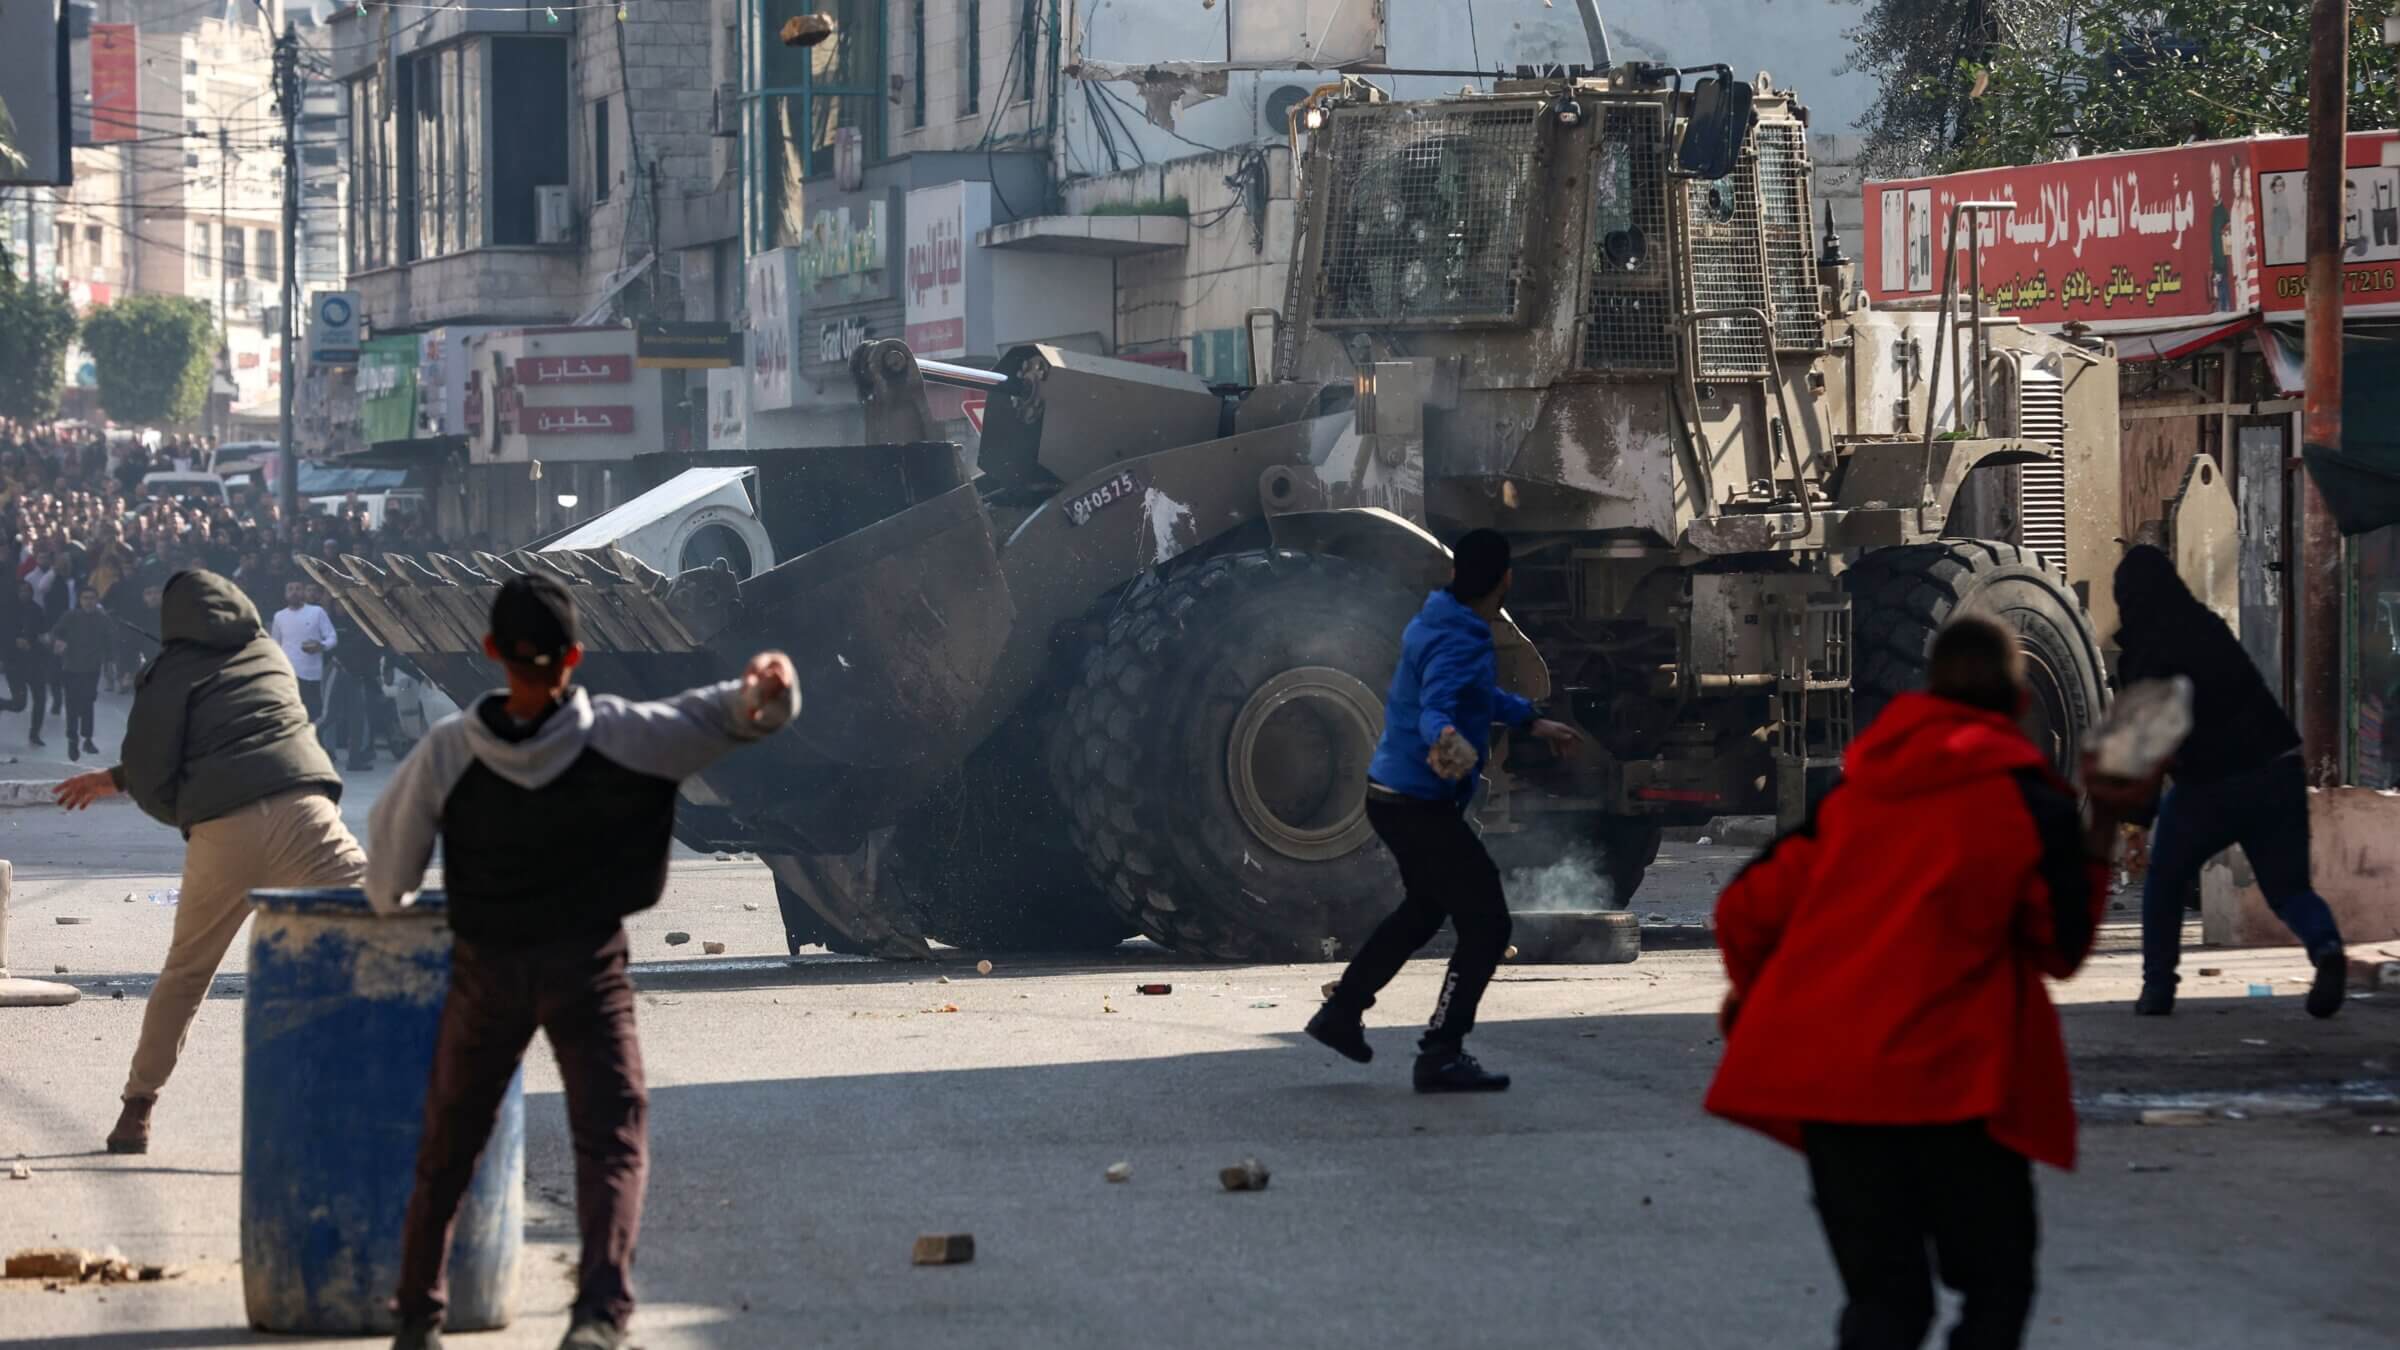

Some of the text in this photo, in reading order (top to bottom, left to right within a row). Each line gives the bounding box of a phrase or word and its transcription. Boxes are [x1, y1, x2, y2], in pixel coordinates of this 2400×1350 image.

[1940, 186, 2001, 268] الجهة
[2072, 175, 2126, 259] العامر
[2127, 170, 2195, 251] مؤسسة
[2061, 268, 2093, 310] ولادي
[2103, 265, 2135, 308] بناتي
[2145, 262, 2182, 306] ستاتي
[2277, 268, 2395, 298] 057216
[538, 359, 611, 382] مخابز
[538, 407, 612, 432] حطين
[1073, 474, 1133, 517] 910575
